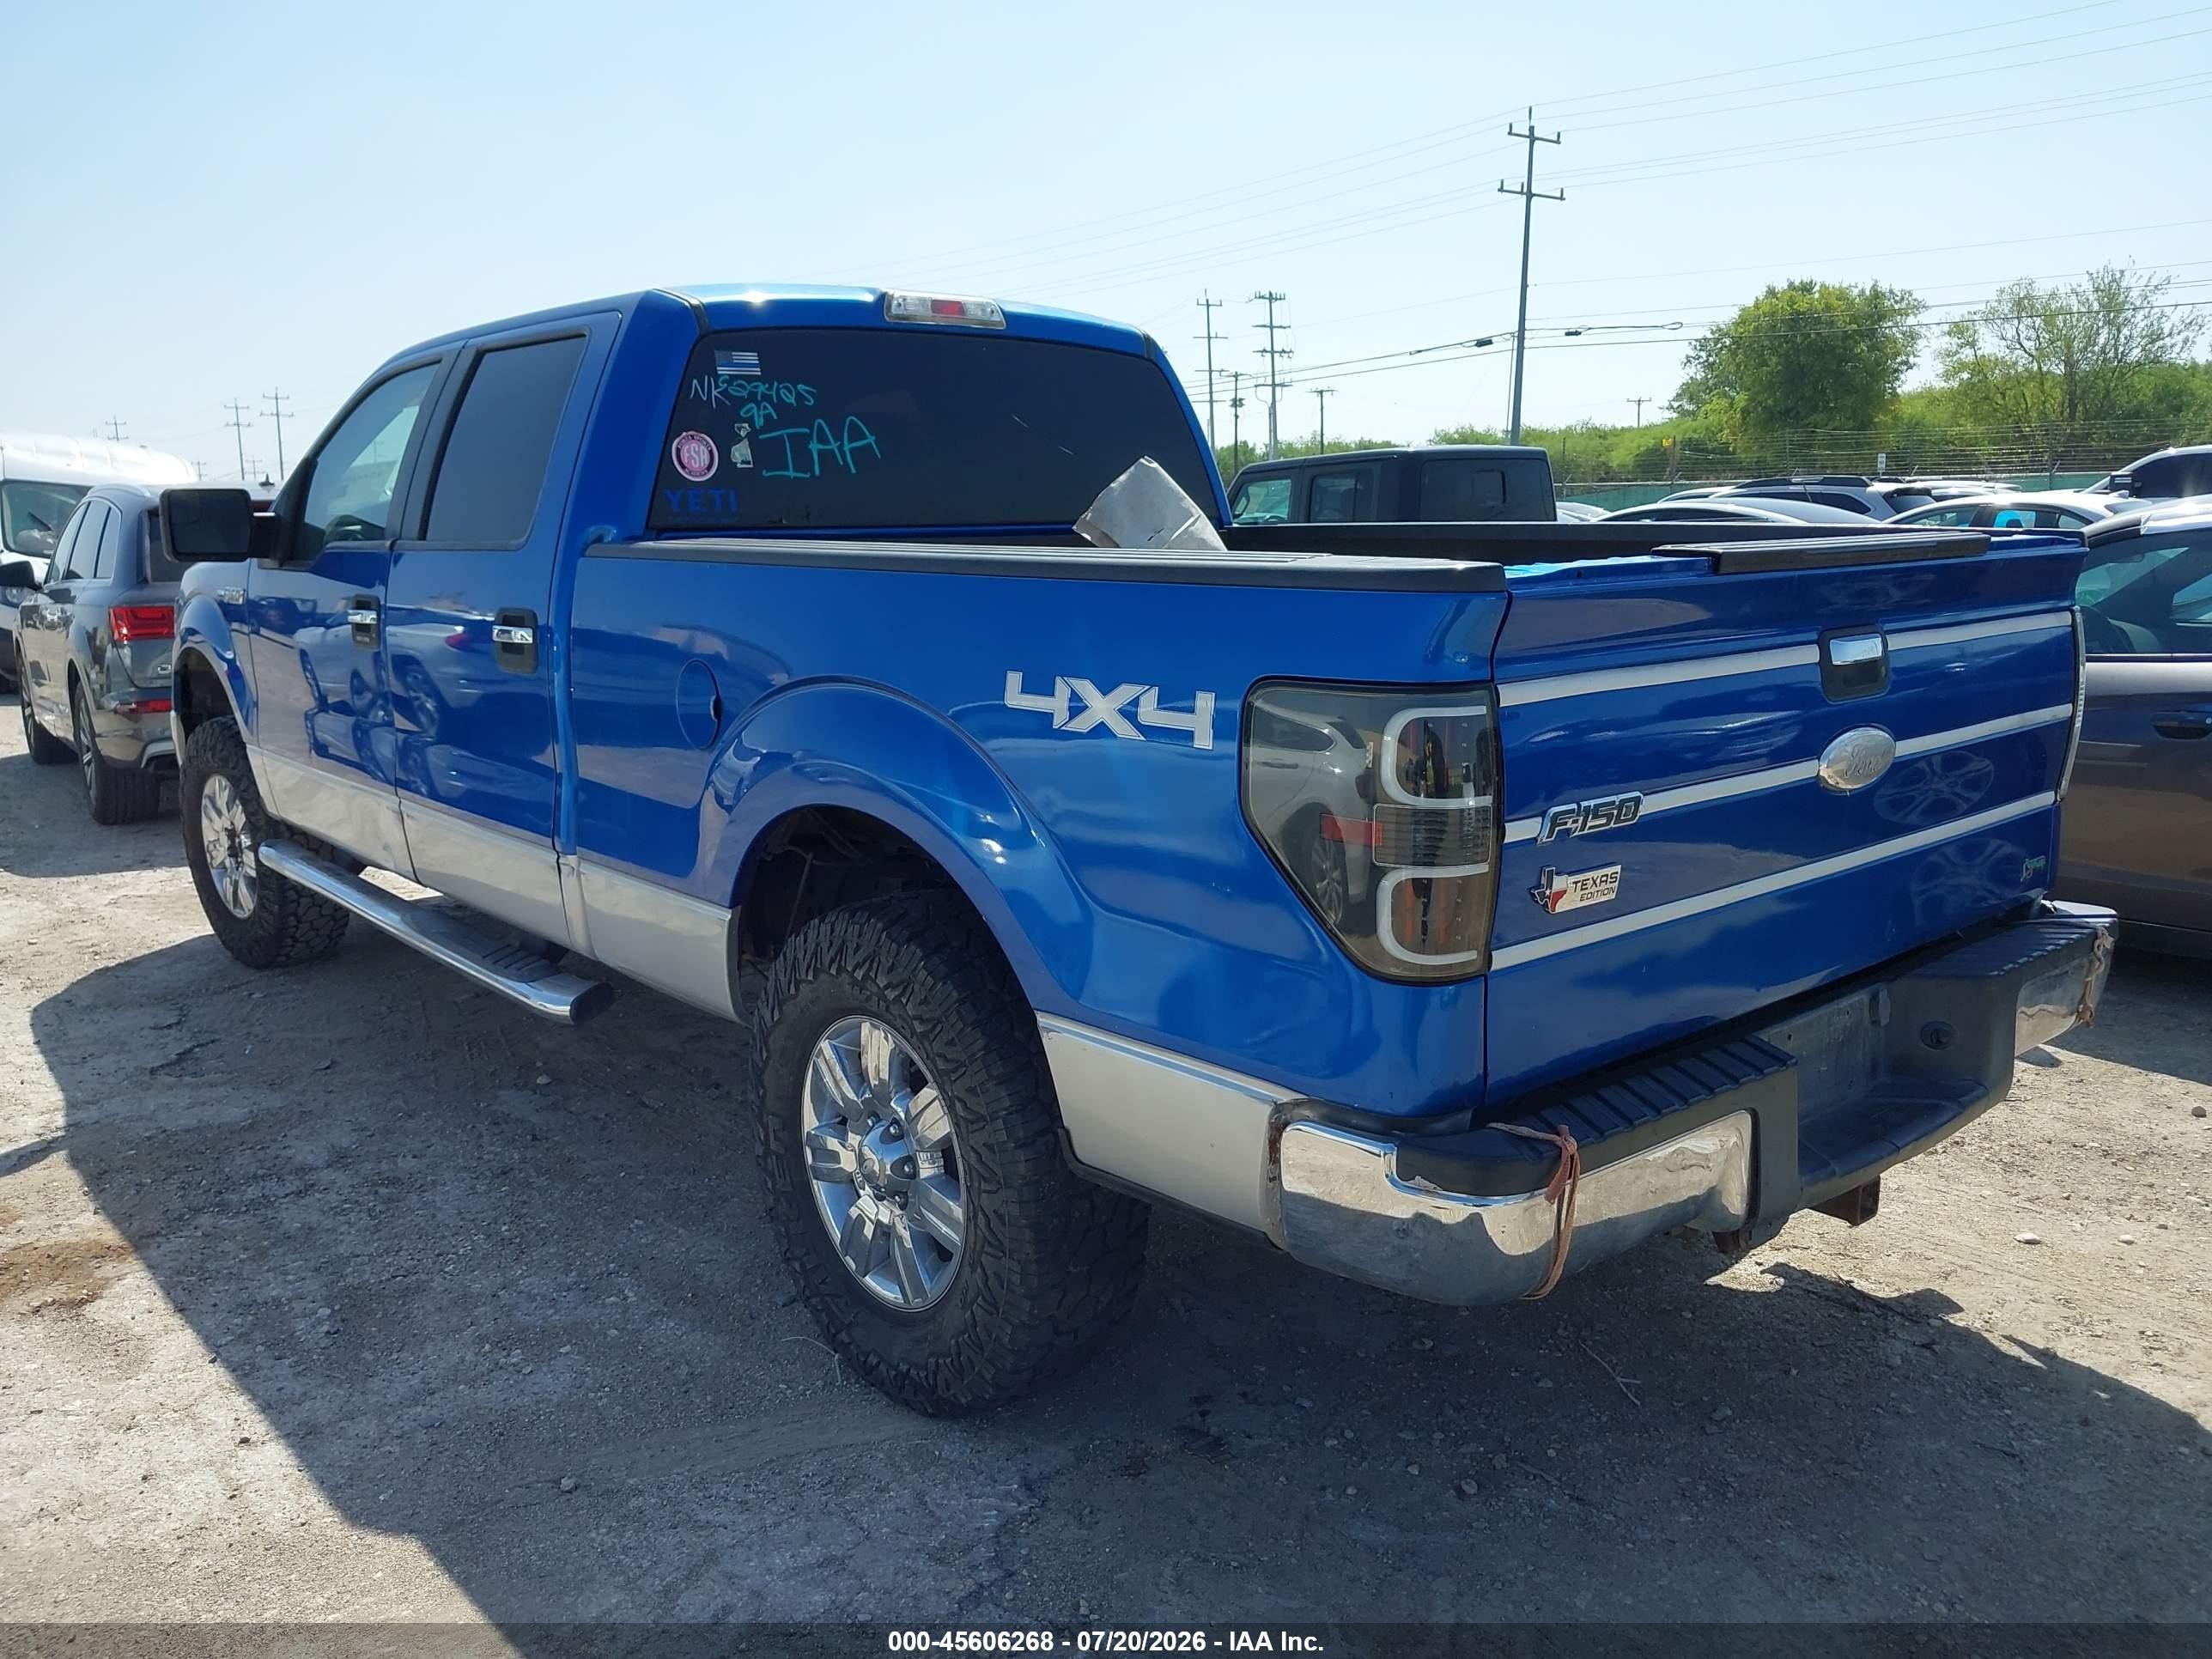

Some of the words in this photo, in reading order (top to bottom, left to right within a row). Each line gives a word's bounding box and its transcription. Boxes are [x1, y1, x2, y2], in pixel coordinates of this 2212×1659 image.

[758, 416, 881, 478] IAA
[665, 489, 737, 512] YETI
[1571, 871, 1619, 893] TEXAS
[1579, 886, 1615, 902] EDITION
